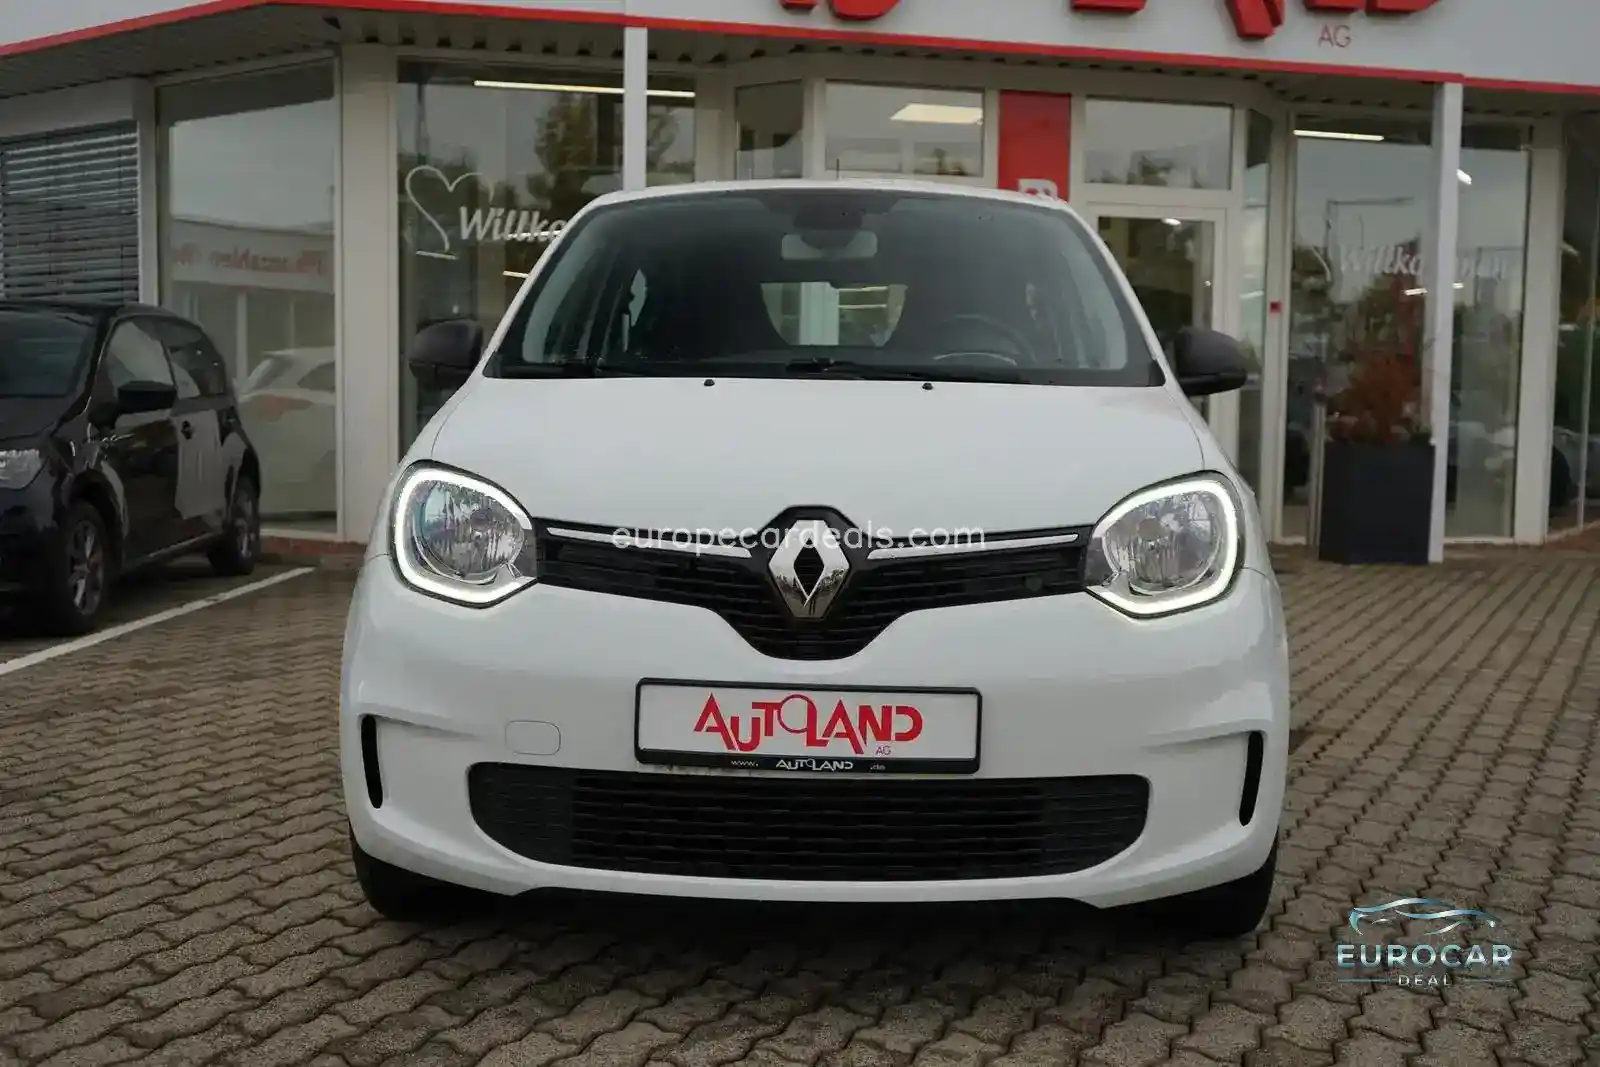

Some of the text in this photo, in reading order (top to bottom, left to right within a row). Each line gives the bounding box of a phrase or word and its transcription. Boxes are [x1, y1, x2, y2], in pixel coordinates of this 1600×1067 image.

[1317, 24, 1352, 48] AG
[875, 746, 892, 756] AG
[730, 759, 759, 768] www.
